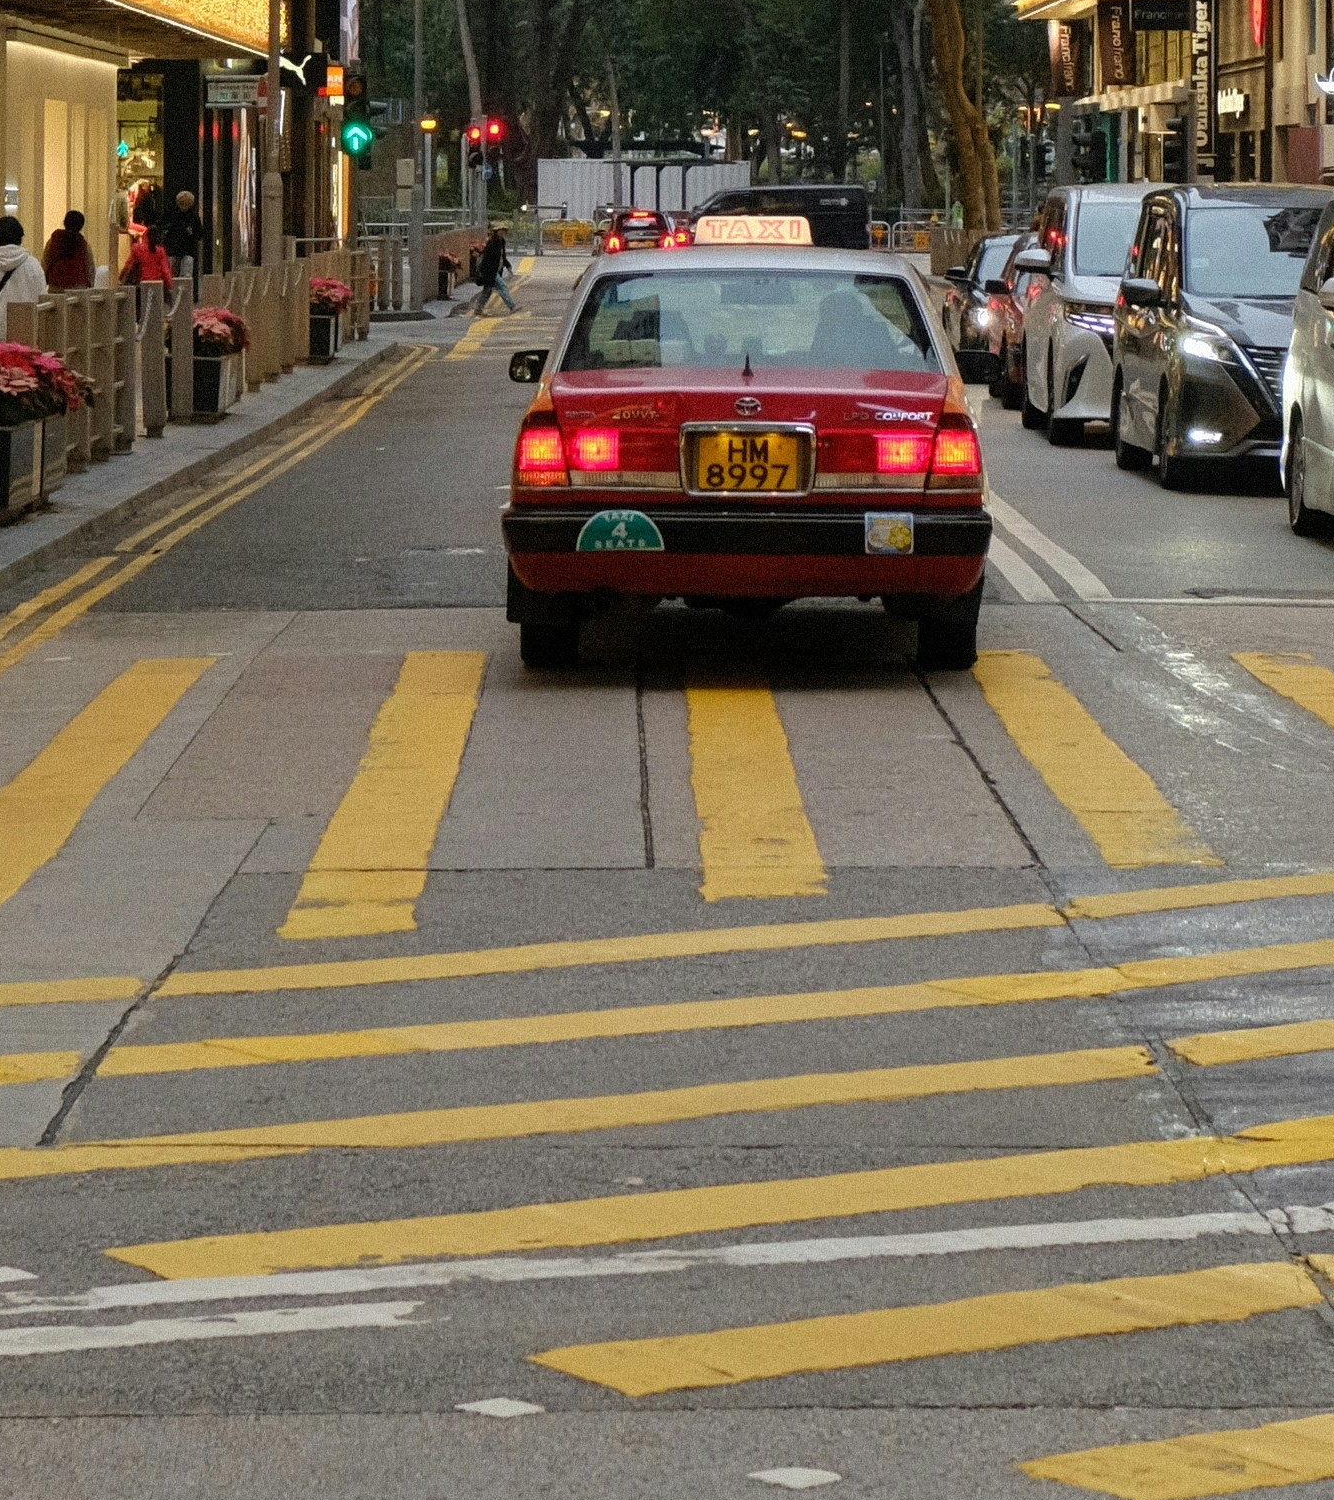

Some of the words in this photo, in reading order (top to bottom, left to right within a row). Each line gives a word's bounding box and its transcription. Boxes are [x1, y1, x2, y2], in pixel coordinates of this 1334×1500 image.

[1191, 0, 1212, 54] Tiger
[706, 219, 801, 240] TAXI
[874, 411, 934, 421] COMFORT
[727, 439, 769, 464] HM
[705, 464, 789, 488] 8997
[603, 512, 634, 522] TAXI
[611, 522, 628, 539] 4
[594, 538, 647, 549] SEATS
